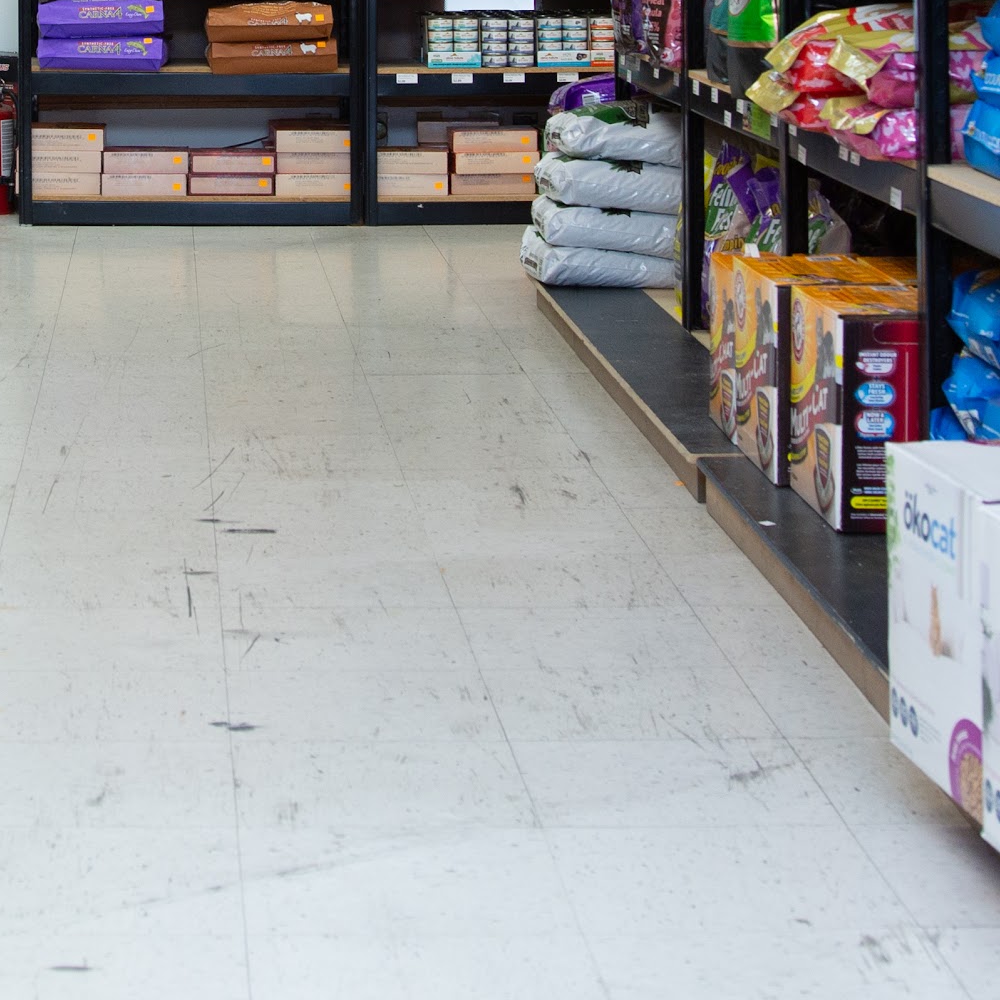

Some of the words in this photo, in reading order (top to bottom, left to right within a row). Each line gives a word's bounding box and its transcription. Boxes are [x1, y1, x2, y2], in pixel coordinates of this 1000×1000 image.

[78, 6, 123, 19] CARNA4
[77, 42, 122, 55] CARNA4
[251, 45, 293, 57] CARNA4
[902, 491, 958, 561] ökocat
